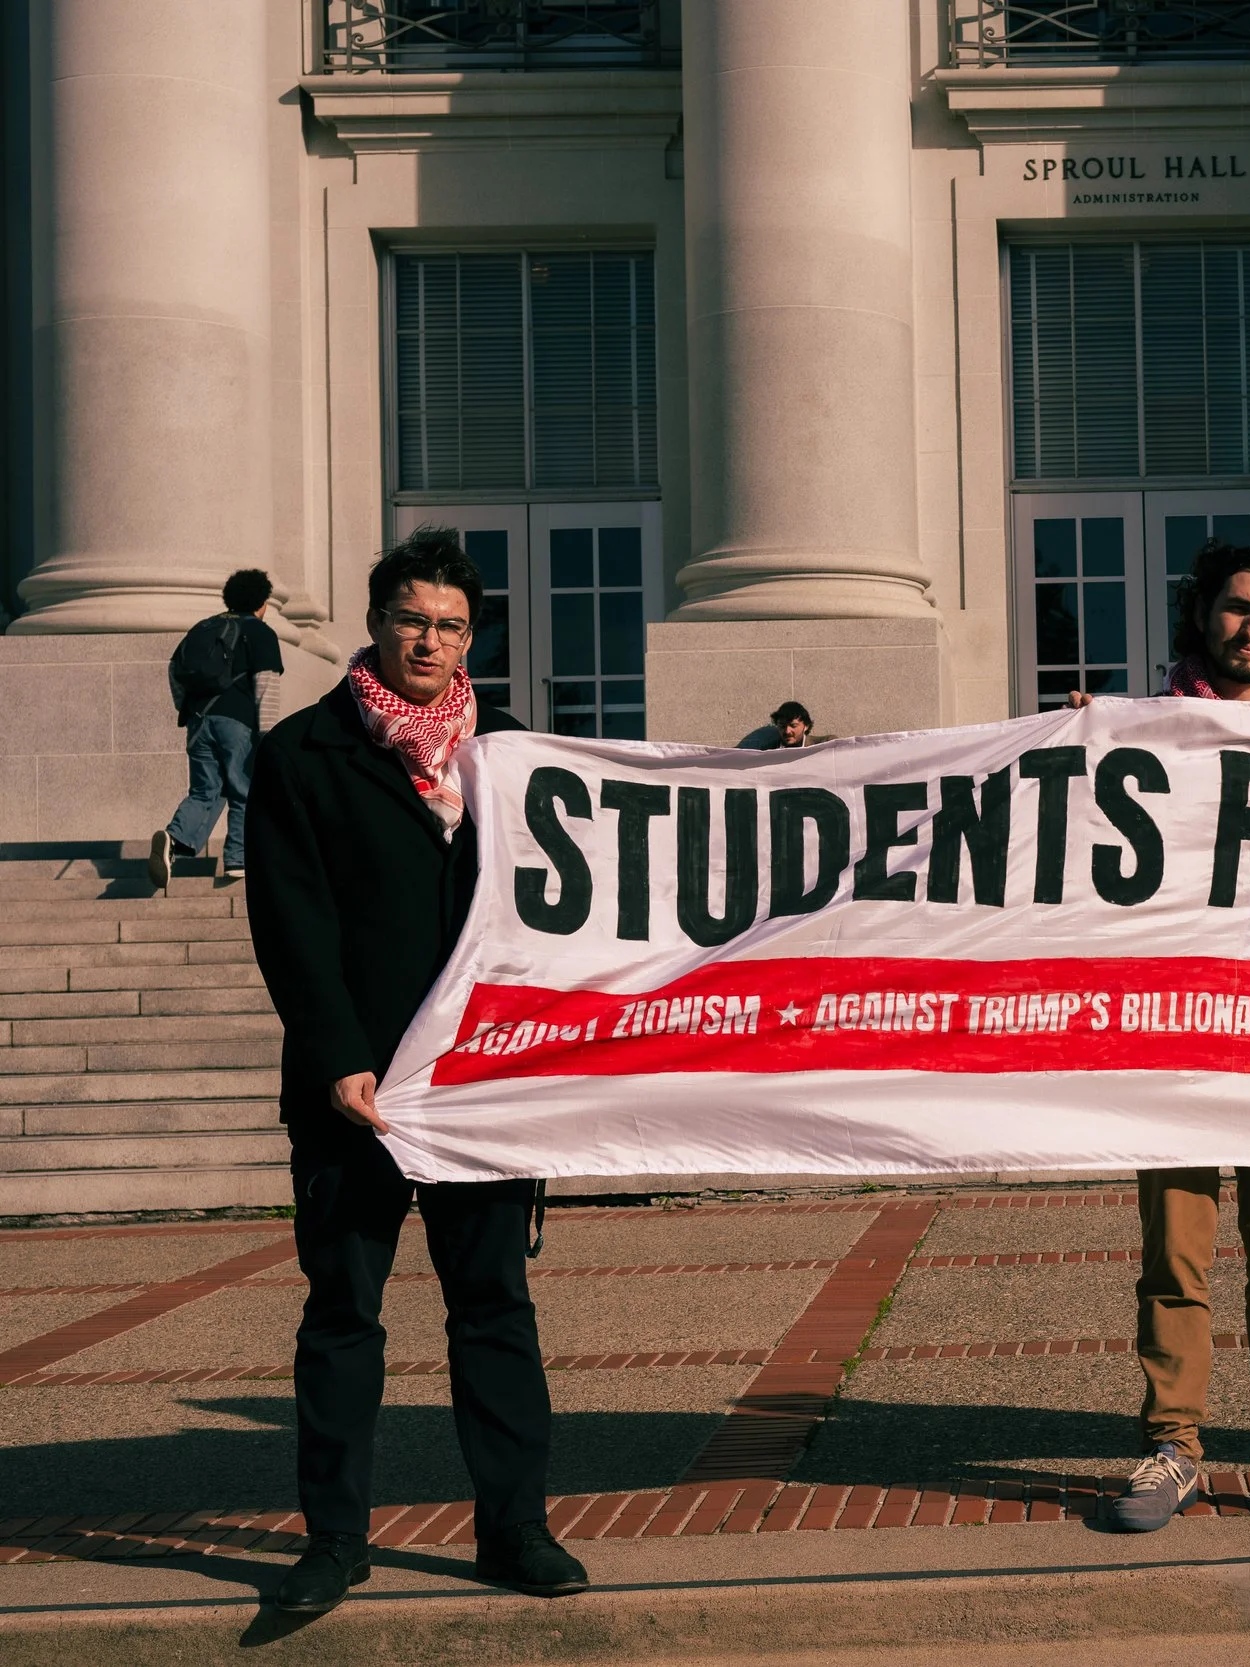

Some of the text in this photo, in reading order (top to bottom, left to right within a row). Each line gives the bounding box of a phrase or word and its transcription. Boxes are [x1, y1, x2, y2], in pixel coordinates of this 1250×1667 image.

[1023, 155, 1247, 181] SPROUL HALL
[1073, 192, 1200, 204] ADMINISTRATION
[514, 745, 1171, 947] STUDENTS
[611, 994, 761, 1039] ZIONISM
[811, 992, 960, 1033] AGAINST
[968, 992, 1111, 1034] TRUMP'S
